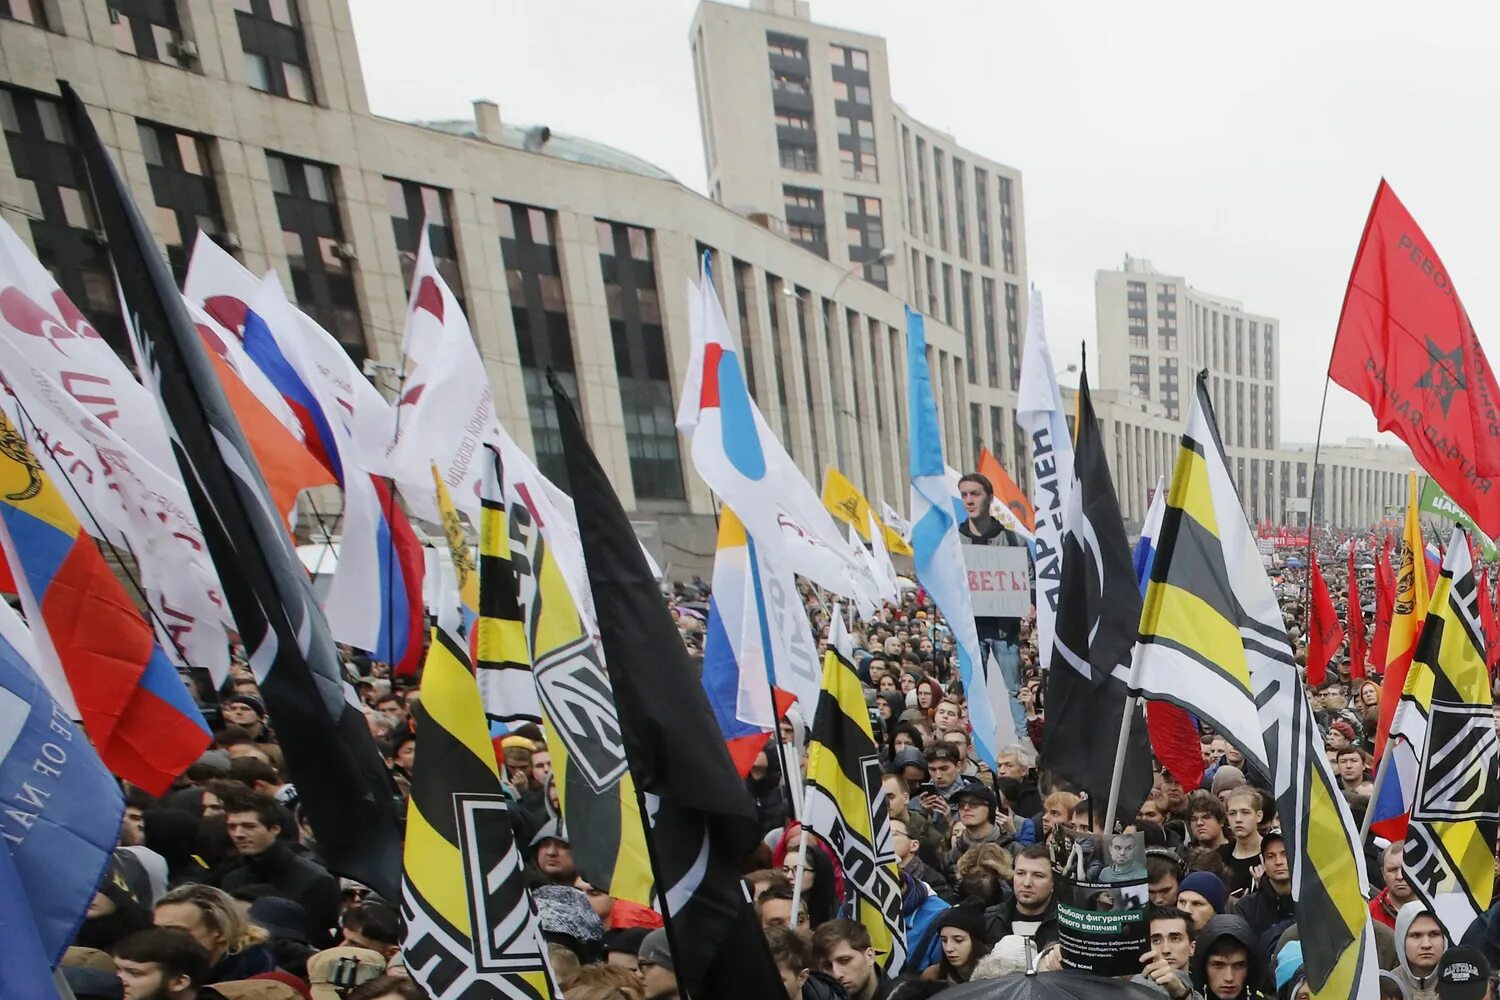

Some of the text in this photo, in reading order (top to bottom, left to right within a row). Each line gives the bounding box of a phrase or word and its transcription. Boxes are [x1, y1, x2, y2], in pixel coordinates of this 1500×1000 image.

[1365, 356, 1424, 428] РАЧАЯ
[1057, 904, 1139, 923] Свободу фигурантам
[1058, 915, 1080, 929] Нового
